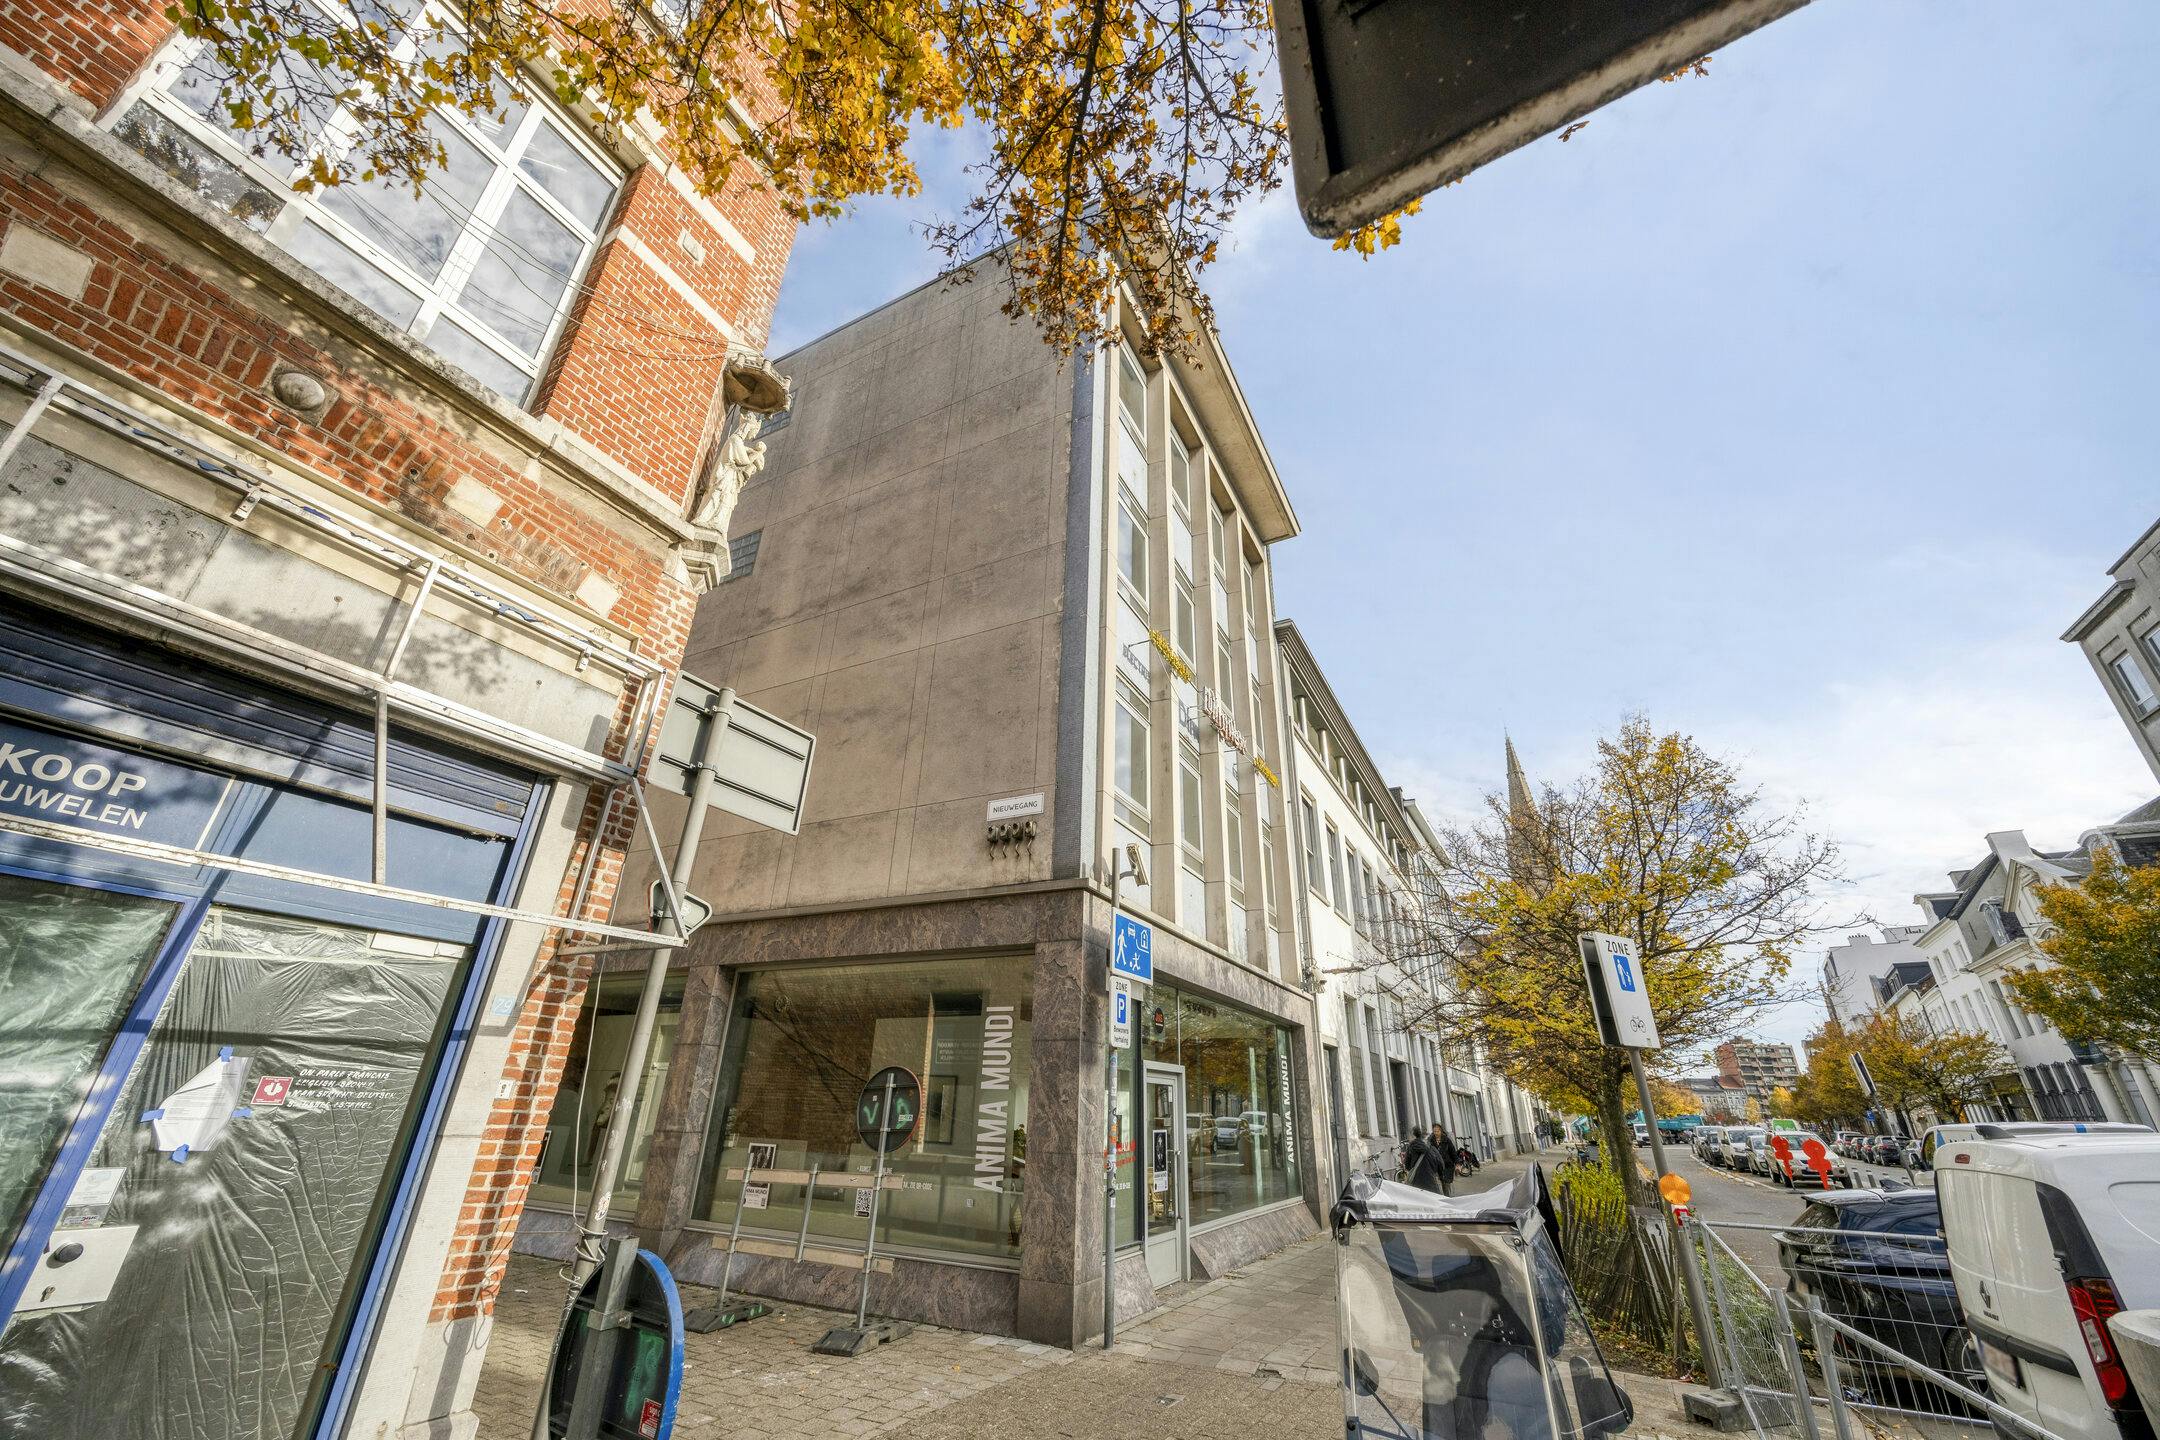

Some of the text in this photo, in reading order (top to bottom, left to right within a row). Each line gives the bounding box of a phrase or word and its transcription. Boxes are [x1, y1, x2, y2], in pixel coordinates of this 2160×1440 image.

[0, 742, 147, 797] KOOP
[992, 800, 1038, 813] NIEUWEGANG
[1605, 940, 1630, 956] ZONE
[1115, 981, 1128, 992] ZONE
[974, 1006, 1014, 1194] ANIMA MUNDI
[1281, 1054, 1294, 1163] ANIMA MUNDI
